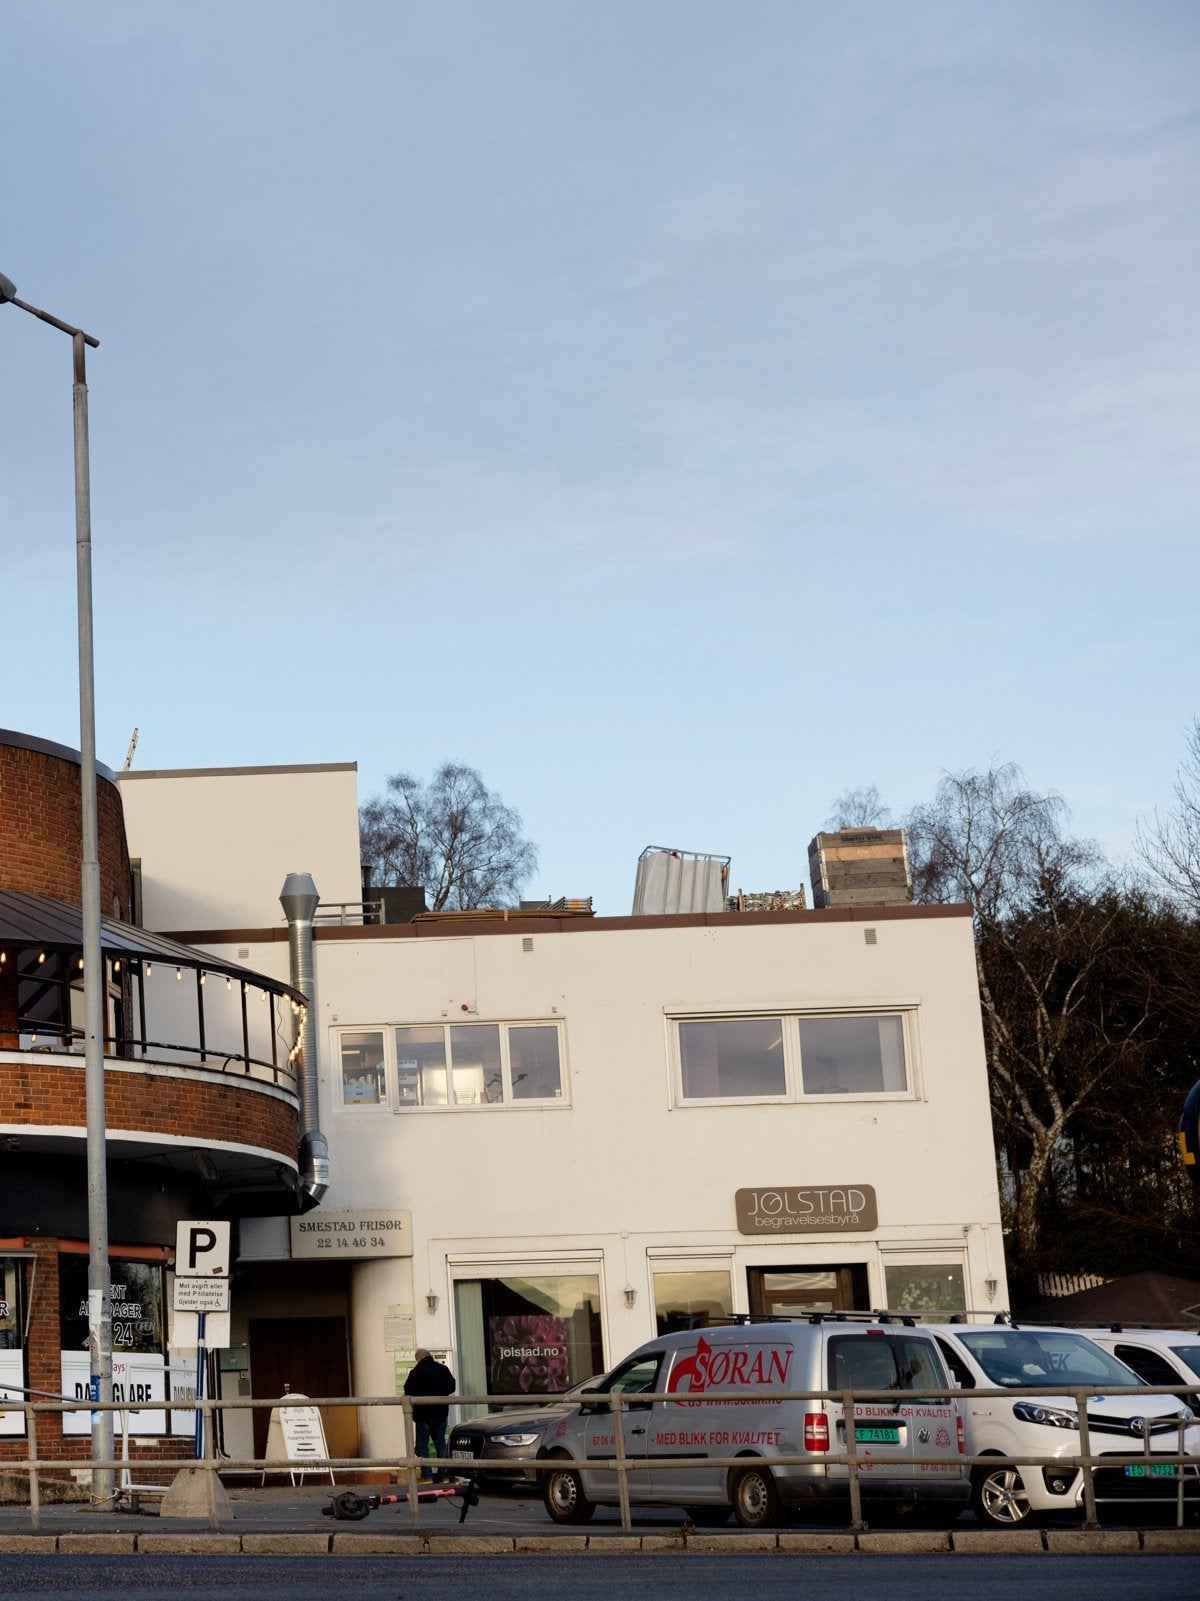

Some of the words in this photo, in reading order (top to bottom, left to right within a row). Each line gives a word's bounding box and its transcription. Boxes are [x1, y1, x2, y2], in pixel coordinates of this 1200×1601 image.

[747, 1189, 866, 1215] JØLSTAD
[299, 1221, 355, 1232] SMESTAD
[359, 1220, 402, 1231] FRISØR
[755, 1212, 860, 1229] begravelsesbyrå
[189, 1228, 217, 1268] P
[317, 1238, 332, 1248] 22
[337, 1238, 348, 1247] 14
[352, 1237, 367, 1247] 46
[370, 1237, 385, 1247] 34
[110, 1285, 127, 1300] ENT
[114, 1321, 134, 1346] 24
[500, 1346, 559, 1360] jolstad.no
[692, 1348, 794, 1387] SØRAN
[865, 1407, 894, 1416] BLIKK
[916, 1408, 952, 1418] KVALITET
[656, 1432, 676, 1445] MED
[679, 1432, 706, 1445] BLIKK
[709, 1431, 730, 1445] FOR
[732, 1431, 780, 1445] KVALITET
[869, 1430, 895, 1440] 74181
